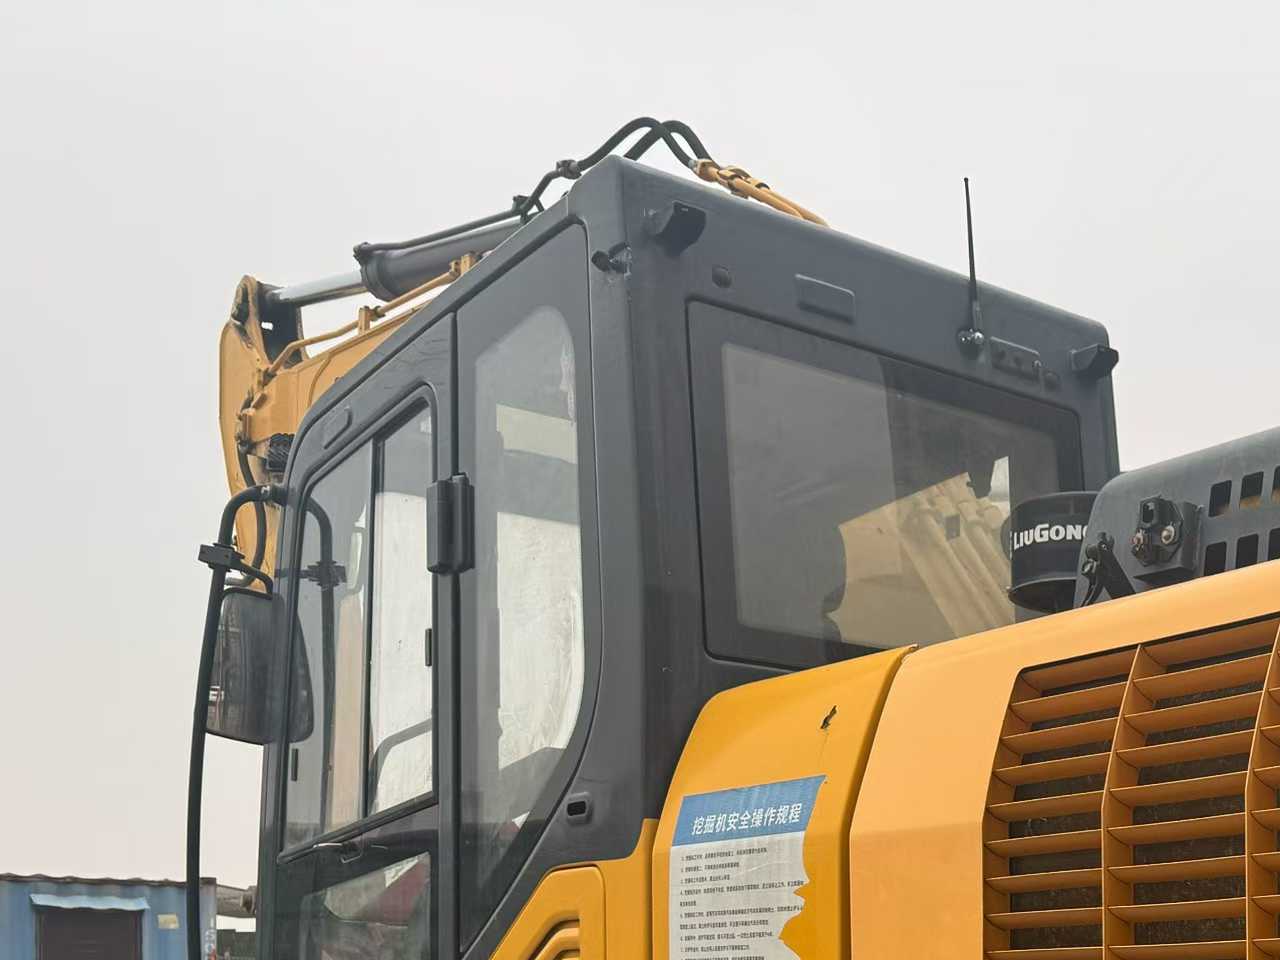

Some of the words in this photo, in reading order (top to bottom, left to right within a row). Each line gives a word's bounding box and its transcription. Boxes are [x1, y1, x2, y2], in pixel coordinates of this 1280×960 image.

[1013, 523, 1089, 551] LIUGON
[691, 802, 802, 836] 挖掘机安全操作规程
